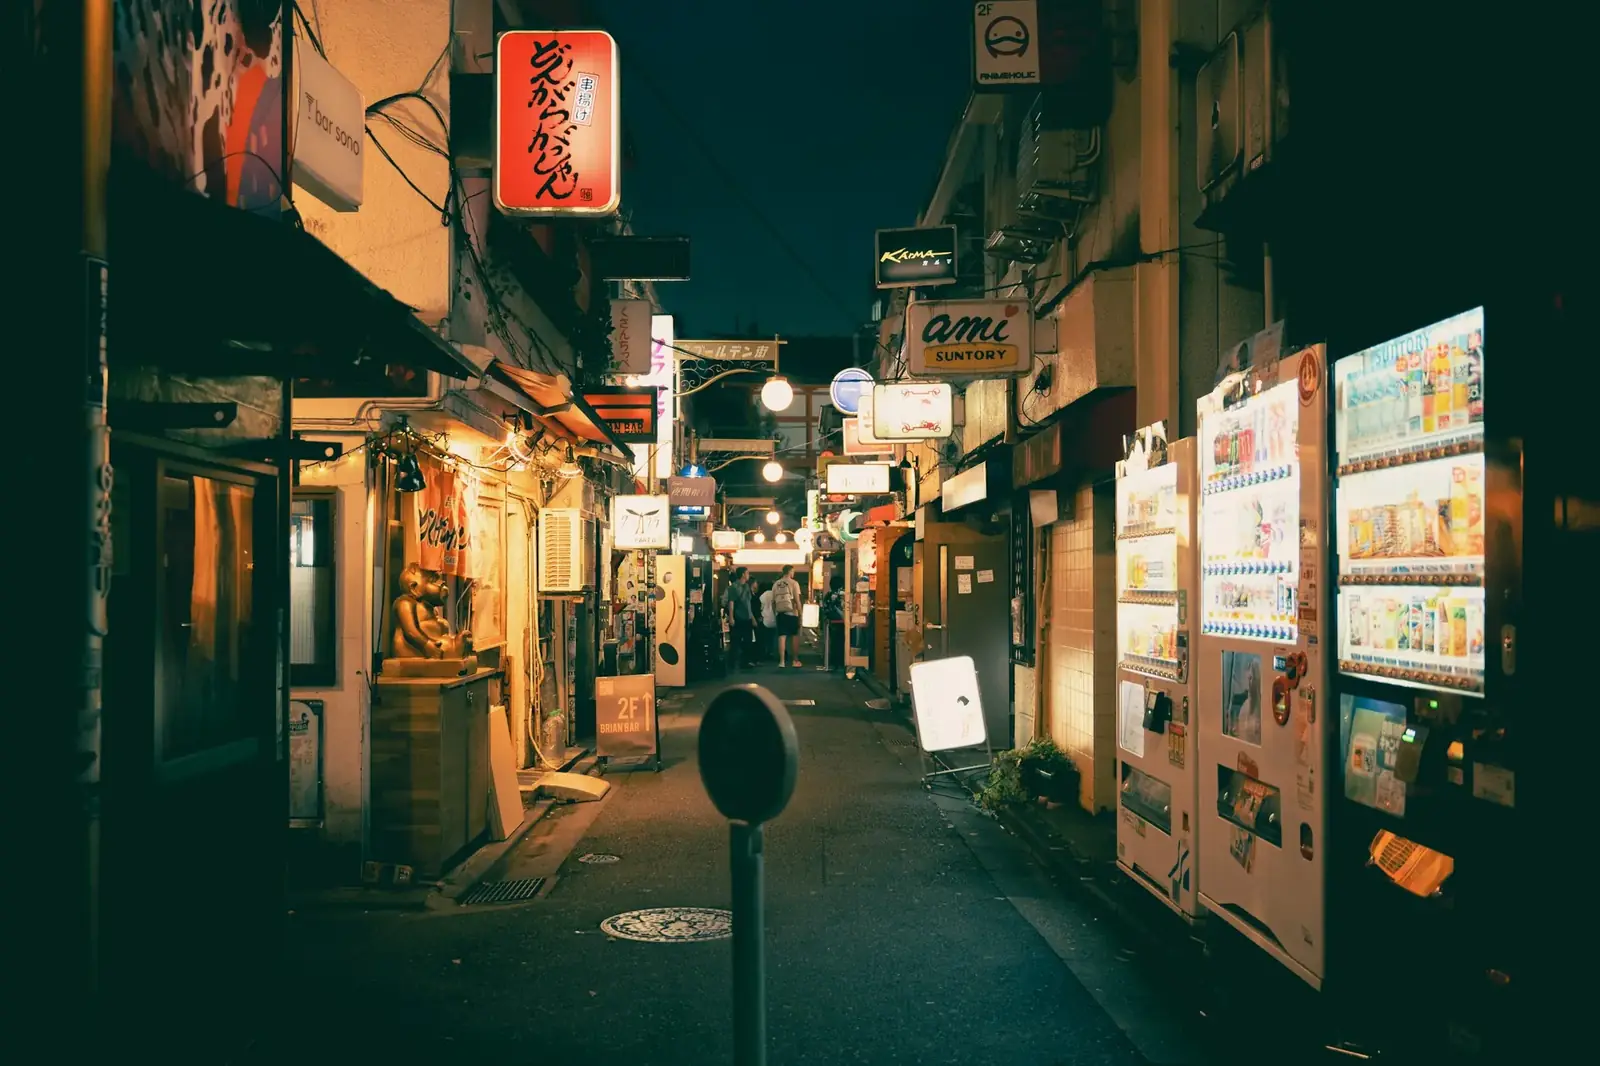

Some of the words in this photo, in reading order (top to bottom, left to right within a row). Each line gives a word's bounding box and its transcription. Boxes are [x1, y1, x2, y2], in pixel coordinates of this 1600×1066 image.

[978, 4, 993, 16] 2F
[980, 71, 1036, 80] ANIMEHOLIC
[575, 78, 593, 120] 串揚げ
[315, 99, 334, 135] bar
[335, 126, 360, 156] sono
[527, 40, 581, 201] どんがらがっしゃん
[922, 312, 1009, 344] ami
[935, 349, 1007, 362] SUNTORY
[1375, 331, 1430, 367] SUNTORY
[624, 422, 644, 434] BAR
[618, 696, 639, 720] 2F
[600, 722, 623, 734] BRIAN
[624, 722, 640, 733] BAR
